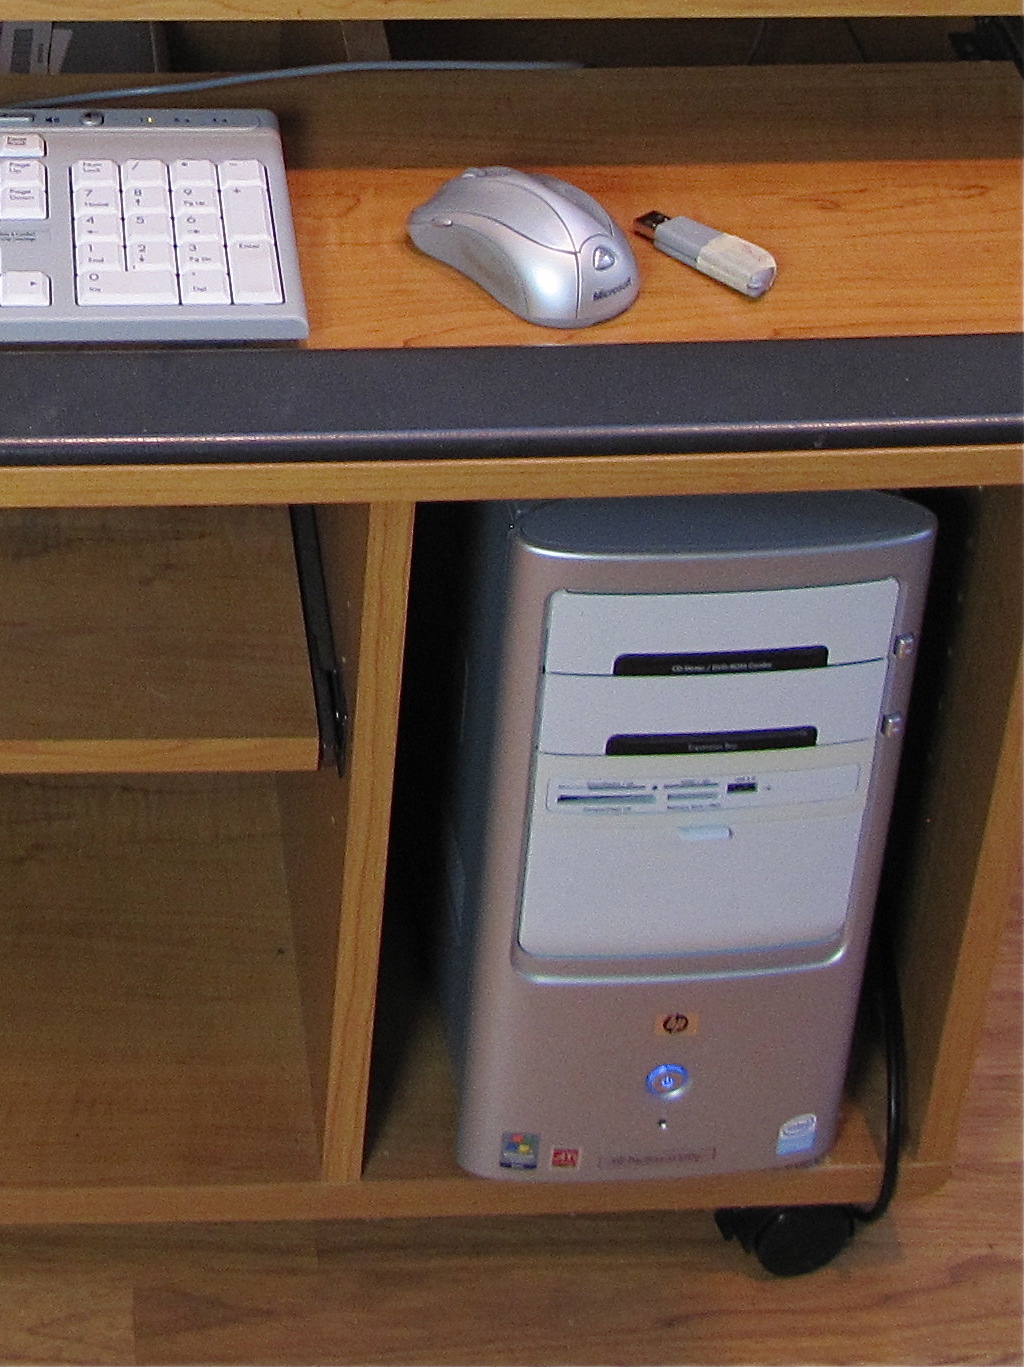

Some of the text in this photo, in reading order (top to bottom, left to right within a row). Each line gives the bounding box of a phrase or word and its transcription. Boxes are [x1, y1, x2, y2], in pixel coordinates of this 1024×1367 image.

[87, 216, 94, 224] 4
[187, 216, 196, 224] 6
[138, 244, 146, 253] 2
[190, 244, 197, 252] 3
[593, 276, 632, 301] Microsoft
